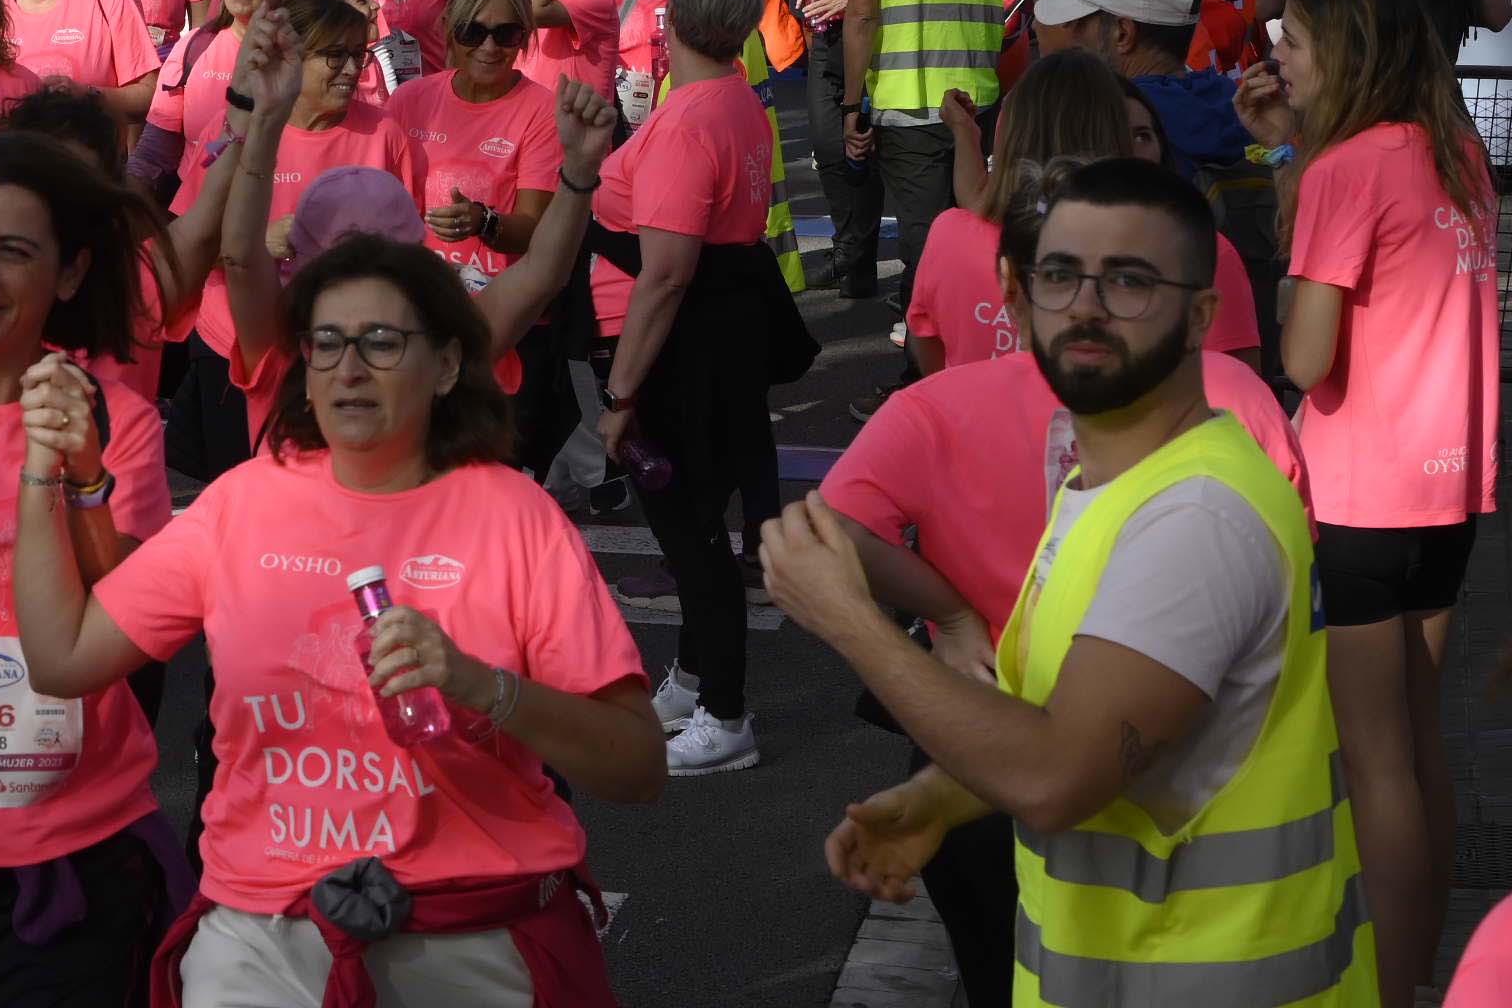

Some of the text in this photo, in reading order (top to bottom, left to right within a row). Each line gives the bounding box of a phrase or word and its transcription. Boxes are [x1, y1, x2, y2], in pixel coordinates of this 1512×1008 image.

[203, 70, 233, 80] OYSH
[273, 172, 301, 184] SHO
[259, 552, 342, 576] OYSHO
[403, 564, 460, 581] ASTURIANA
[243, 691, 306, 733] TU
[262, 746, 436, 799] DORSAL
[268, 803, 397, 853] SUMA
